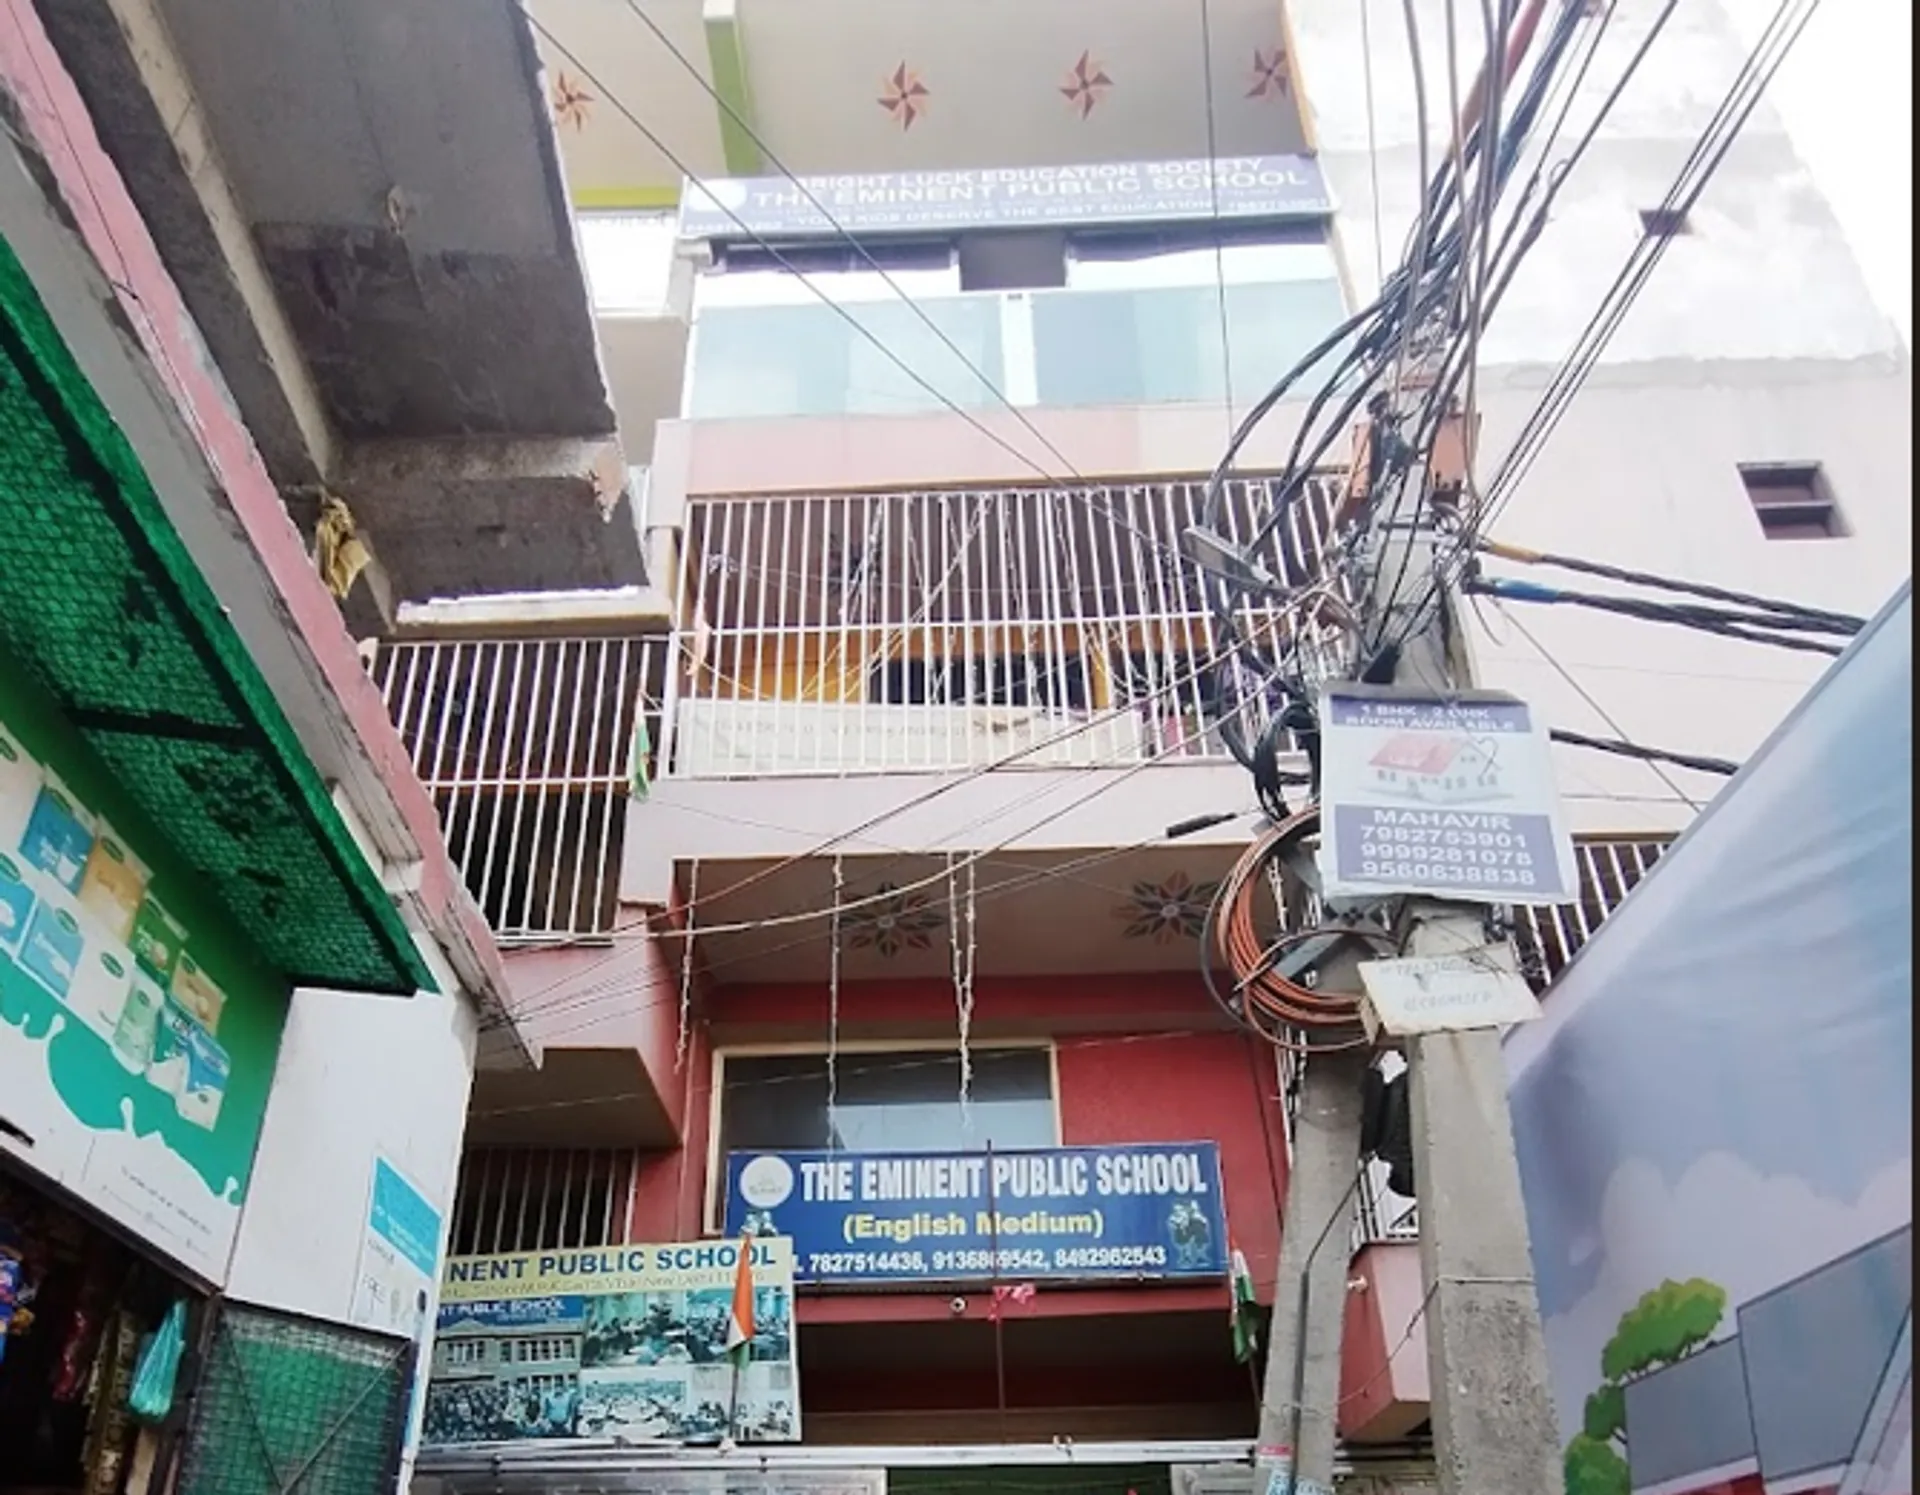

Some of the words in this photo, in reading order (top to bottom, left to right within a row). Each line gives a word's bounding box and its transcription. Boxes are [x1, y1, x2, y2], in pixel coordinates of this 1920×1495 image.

[753, 191, 817, 208] THE
[834, 183, 996, 206] EMINENT
[1006, 177, 1141, 199] PUBLIC
[1153, 170, 1309, 191] SCHOOL
[900, 171, 974, 188] LUCK
[981, 164, 1138, 183] EDUCATION
[1147, 157, 1264, 175] SOCIETY
[1373, 809, 1512, 831] MAHAVIR
[800, 1161, 854, 1202] THE
[861, 1157, 985, 1201] EMINENT
[992, 1155, 1090, 1200] PUBLIC
[1095, 1152, 1208, 1196] SCHOOL
[843, 1211, 968, 1244] (English
[975, 1208, 1104, 1239] Medium)
[538, 1251, 645, 1278] PUBLIC
